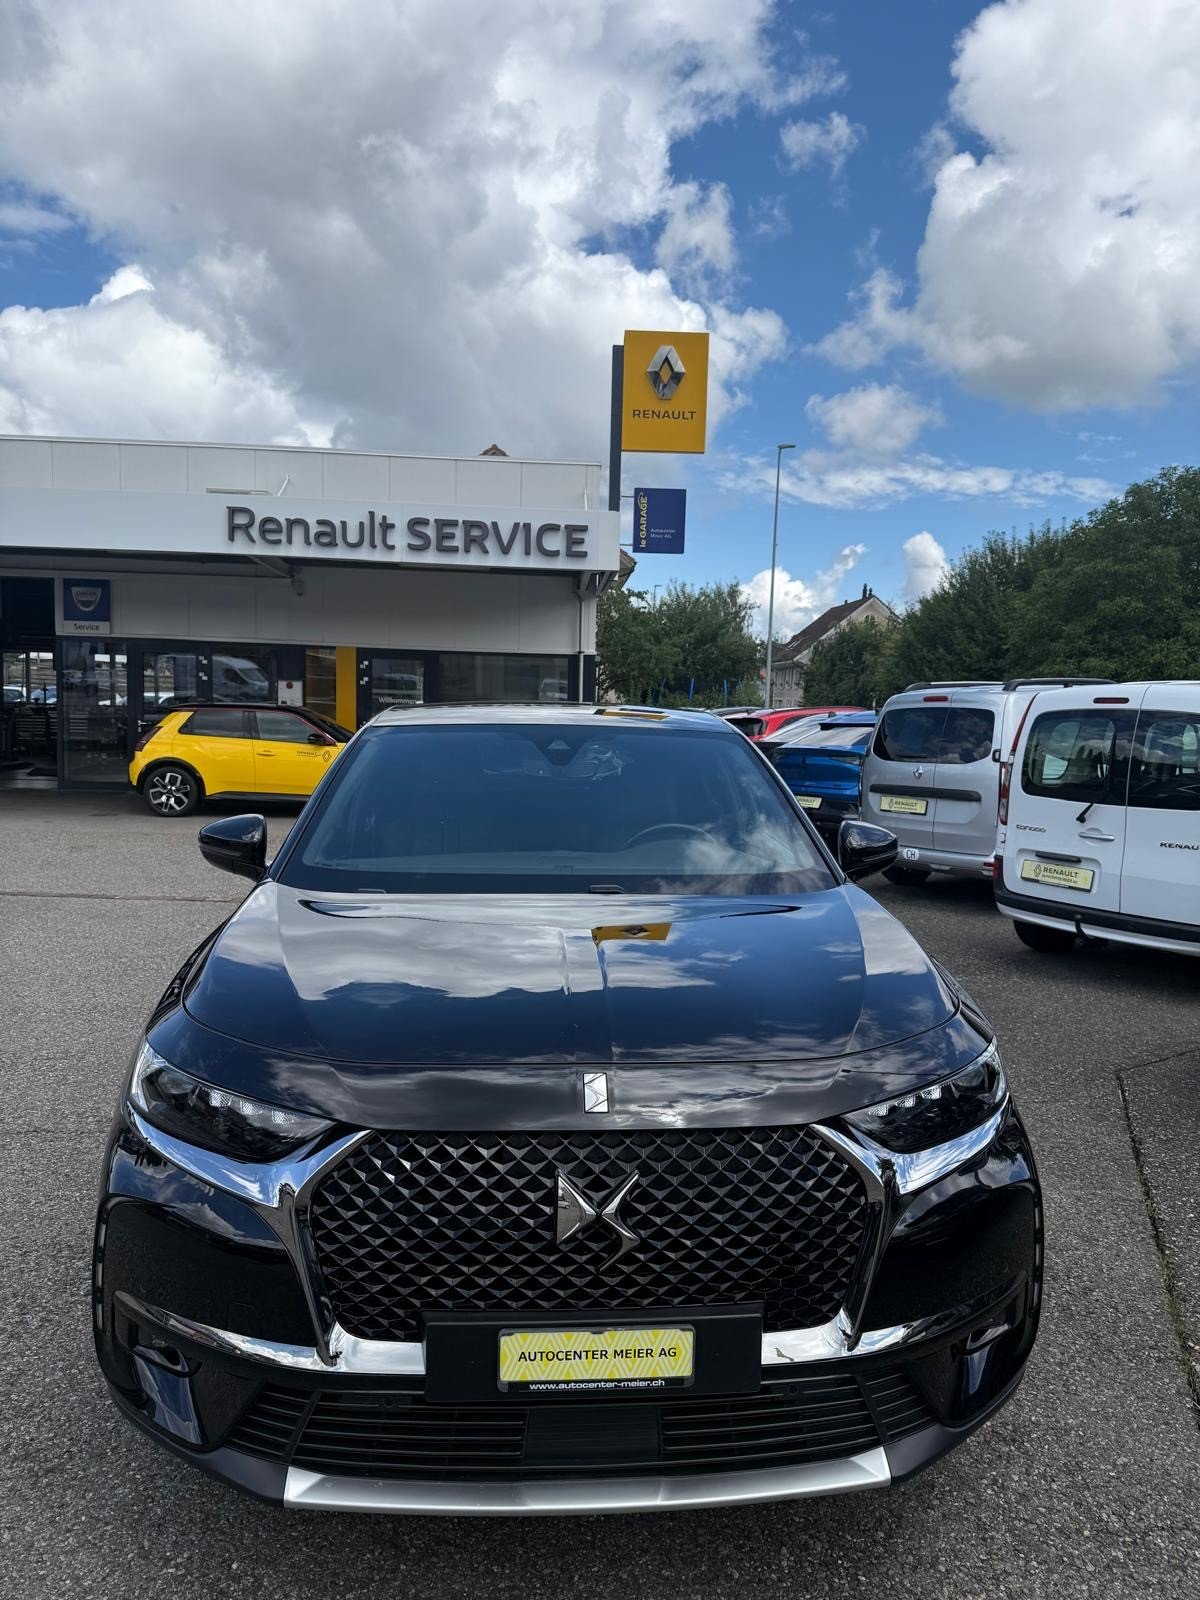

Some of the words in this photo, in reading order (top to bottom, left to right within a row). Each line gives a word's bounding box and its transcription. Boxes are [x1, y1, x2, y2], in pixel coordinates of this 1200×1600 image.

[632, 409, 697, 420] RENAULT
[639, 496, 648, 538] GARAGE
[226, 505, 396, 550] Renault
[407, 516, 589, 557] SERVICE
[73, 623, 100, 631] Service
[906, 849, 916, 860] CH
[1043, 866, 1079, 879] RENAULT
[518, 1350, 609, 1362] AUTOCENTER
[613, 1348, 654, 1359] MEIER
[658, 1347, 677, 1358] AG
[529, 1379, 665, 1390] www.autocenter-meier.ch
